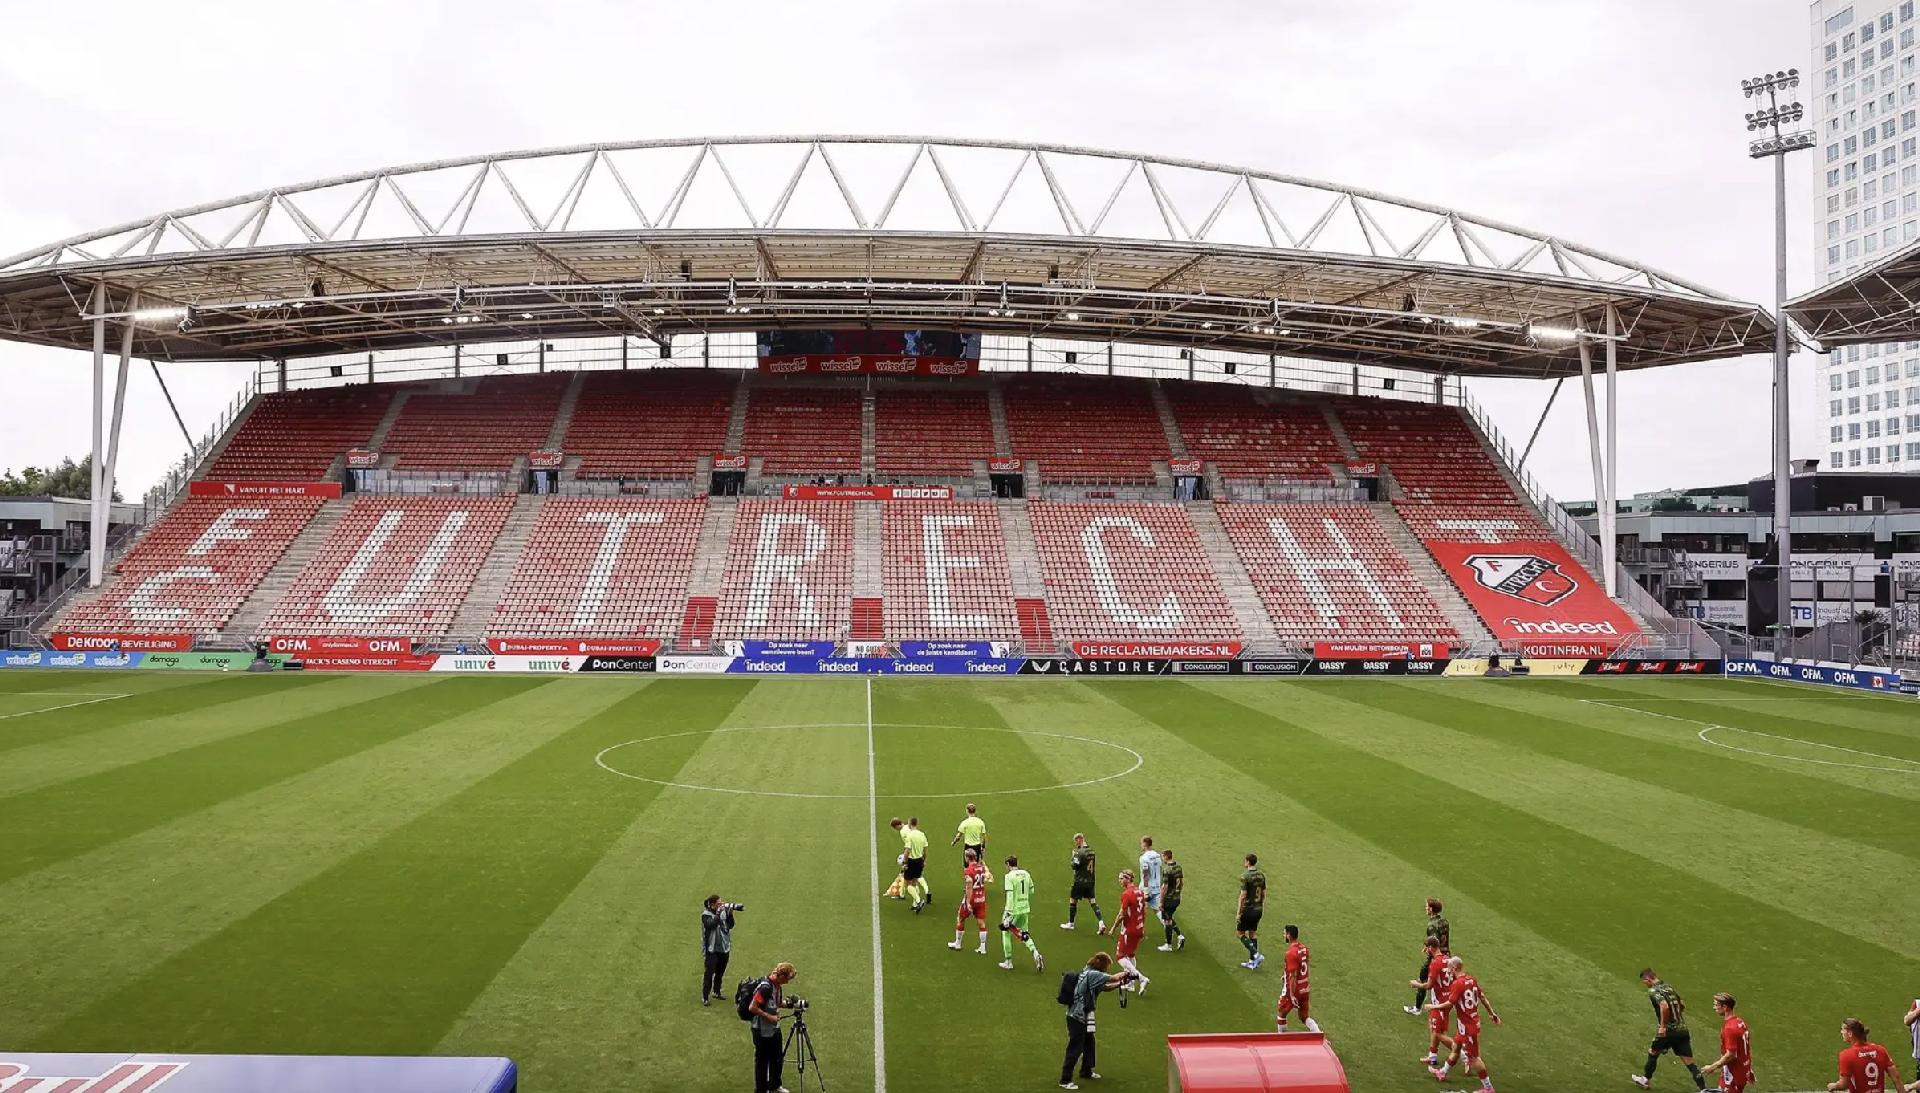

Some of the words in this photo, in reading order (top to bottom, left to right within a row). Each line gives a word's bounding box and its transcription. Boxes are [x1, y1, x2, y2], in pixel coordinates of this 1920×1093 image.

[770, 358, 803, 373] wissel
[821, 358, 856, 371] wissel
[876, 359, 911, 372] wissel
[930, 362, 962, 375] wissel
[1790, 560, 1851, 569] ONGERIUS
[1501, 558, 1550, 596] UTRECHT
[1505, 617, 1617, 636] indeed
[121, 639, 177, 648] BEVEILIGING
[1081, 645, 1098, 656] DE
[1100, 645, 1233, 656] RECLAMEMAKERS.NL
[1523, 644, 1604, 656] KOOTINFRA.NL
[305, 658, 330, 666] JACK'S
[332, 658, 361, 666] CASINO
[363, 658, 398, 666] UTRECHT
[454, 657, 496, 671] univé
[528, 657, 570, 671] univé
[593, 659, 653, 670] PonCenter
[663, 660, 723, 670] PonCenter
[745, 659, 786, 672] indeed
[818, 659, 858, 672] indeed
[892, 660, 934, 672] indeed
[966, 660, 1006, 673] indeed
[1059, 661, 1155, 673] CASTORE
[1184, 663, 1226, 671] CONCLUSION
[1255, 663, 1296, 671] CONCLUSION
[1319, 661, 1346, 670] DASSY
[1363, 661, 1391, 670] DASSY
[1408, 661, 1434, 670] DASSY
[1136, 896, 1144, 913] 3
[1865, 1062, 1879, 1086] 9
